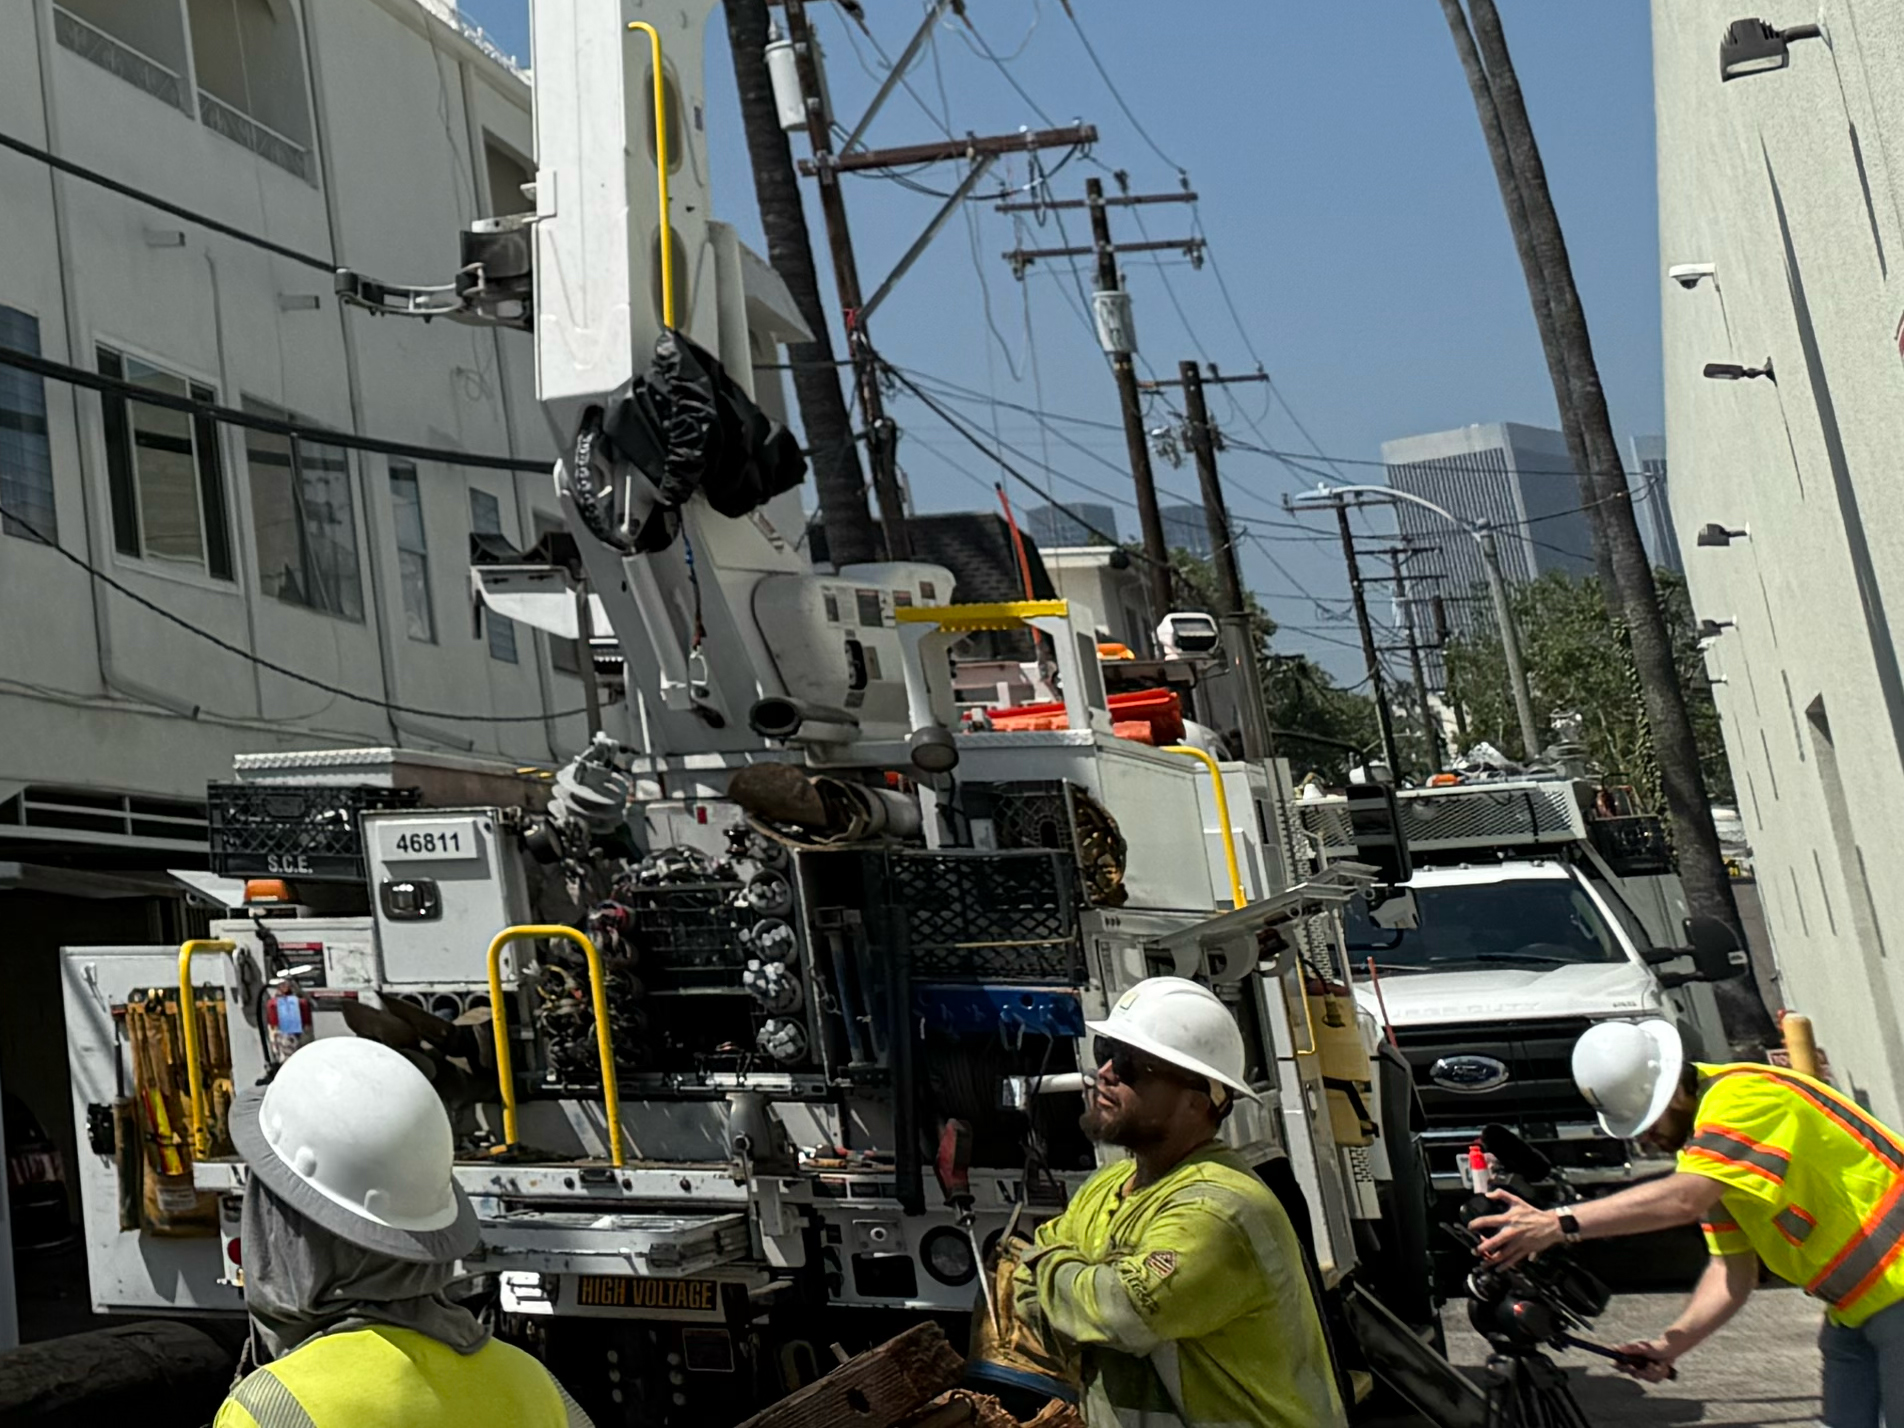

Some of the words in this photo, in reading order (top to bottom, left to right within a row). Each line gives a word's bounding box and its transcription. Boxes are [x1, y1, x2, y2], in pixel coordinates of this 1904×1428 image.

[396, 832, 461, 853] 46811
[267, 854, 314, 874] S.C.E.
[581, 1276, 626, 1305] HIGH
[633, 1278, 713, 1309] VOLTAGE
